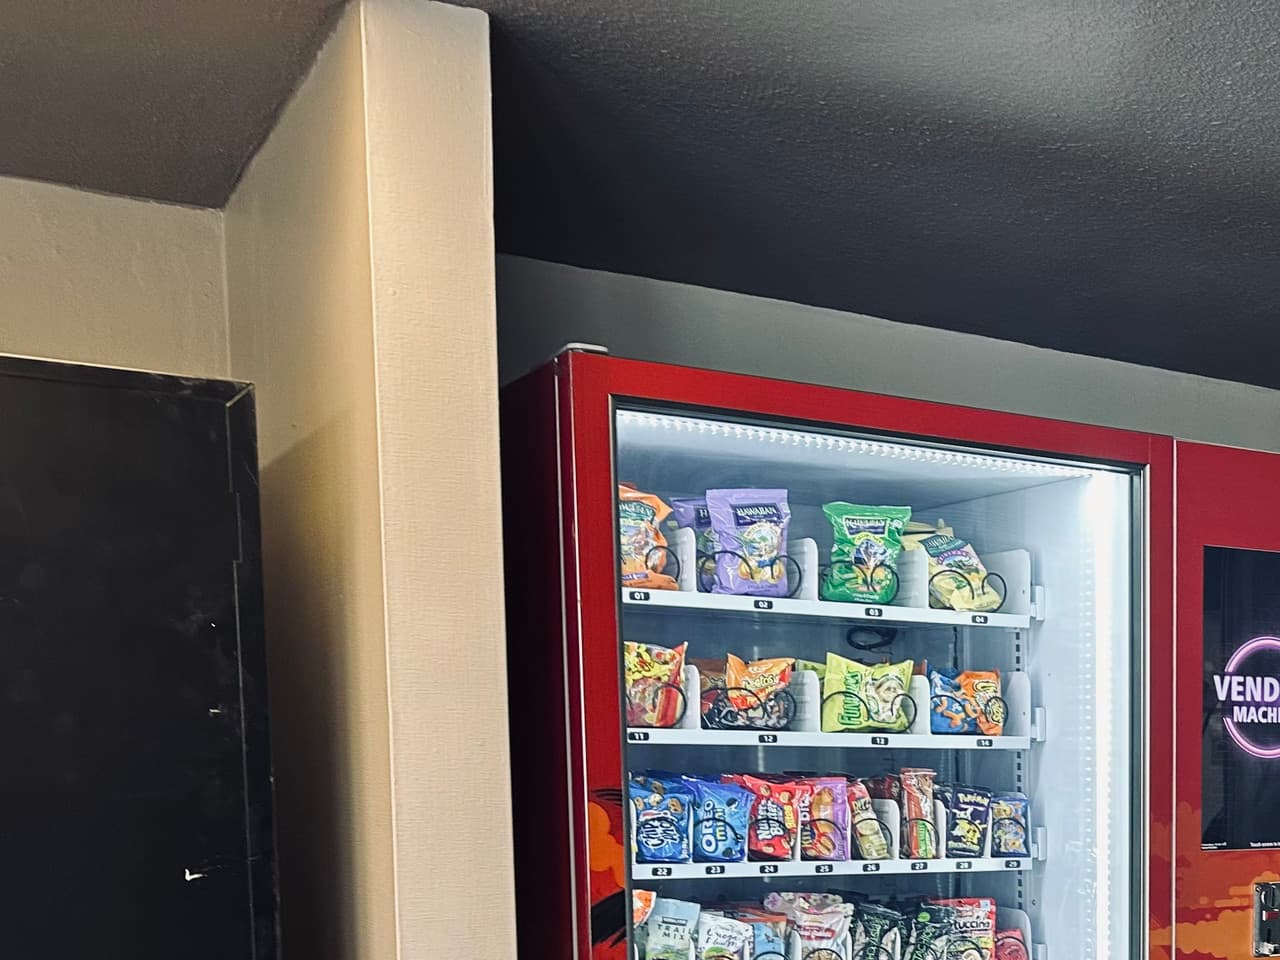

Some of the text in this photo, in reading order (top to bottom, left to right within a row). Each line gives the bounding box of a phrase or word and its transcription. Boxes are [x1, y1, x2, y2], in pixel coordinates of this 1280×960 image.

[702, 800, 718, 853] OREO
[715, 808, 728, 841] mini
[657, 924, 693, 935] TRAIL
[662, 931, 685, 940] MIX
